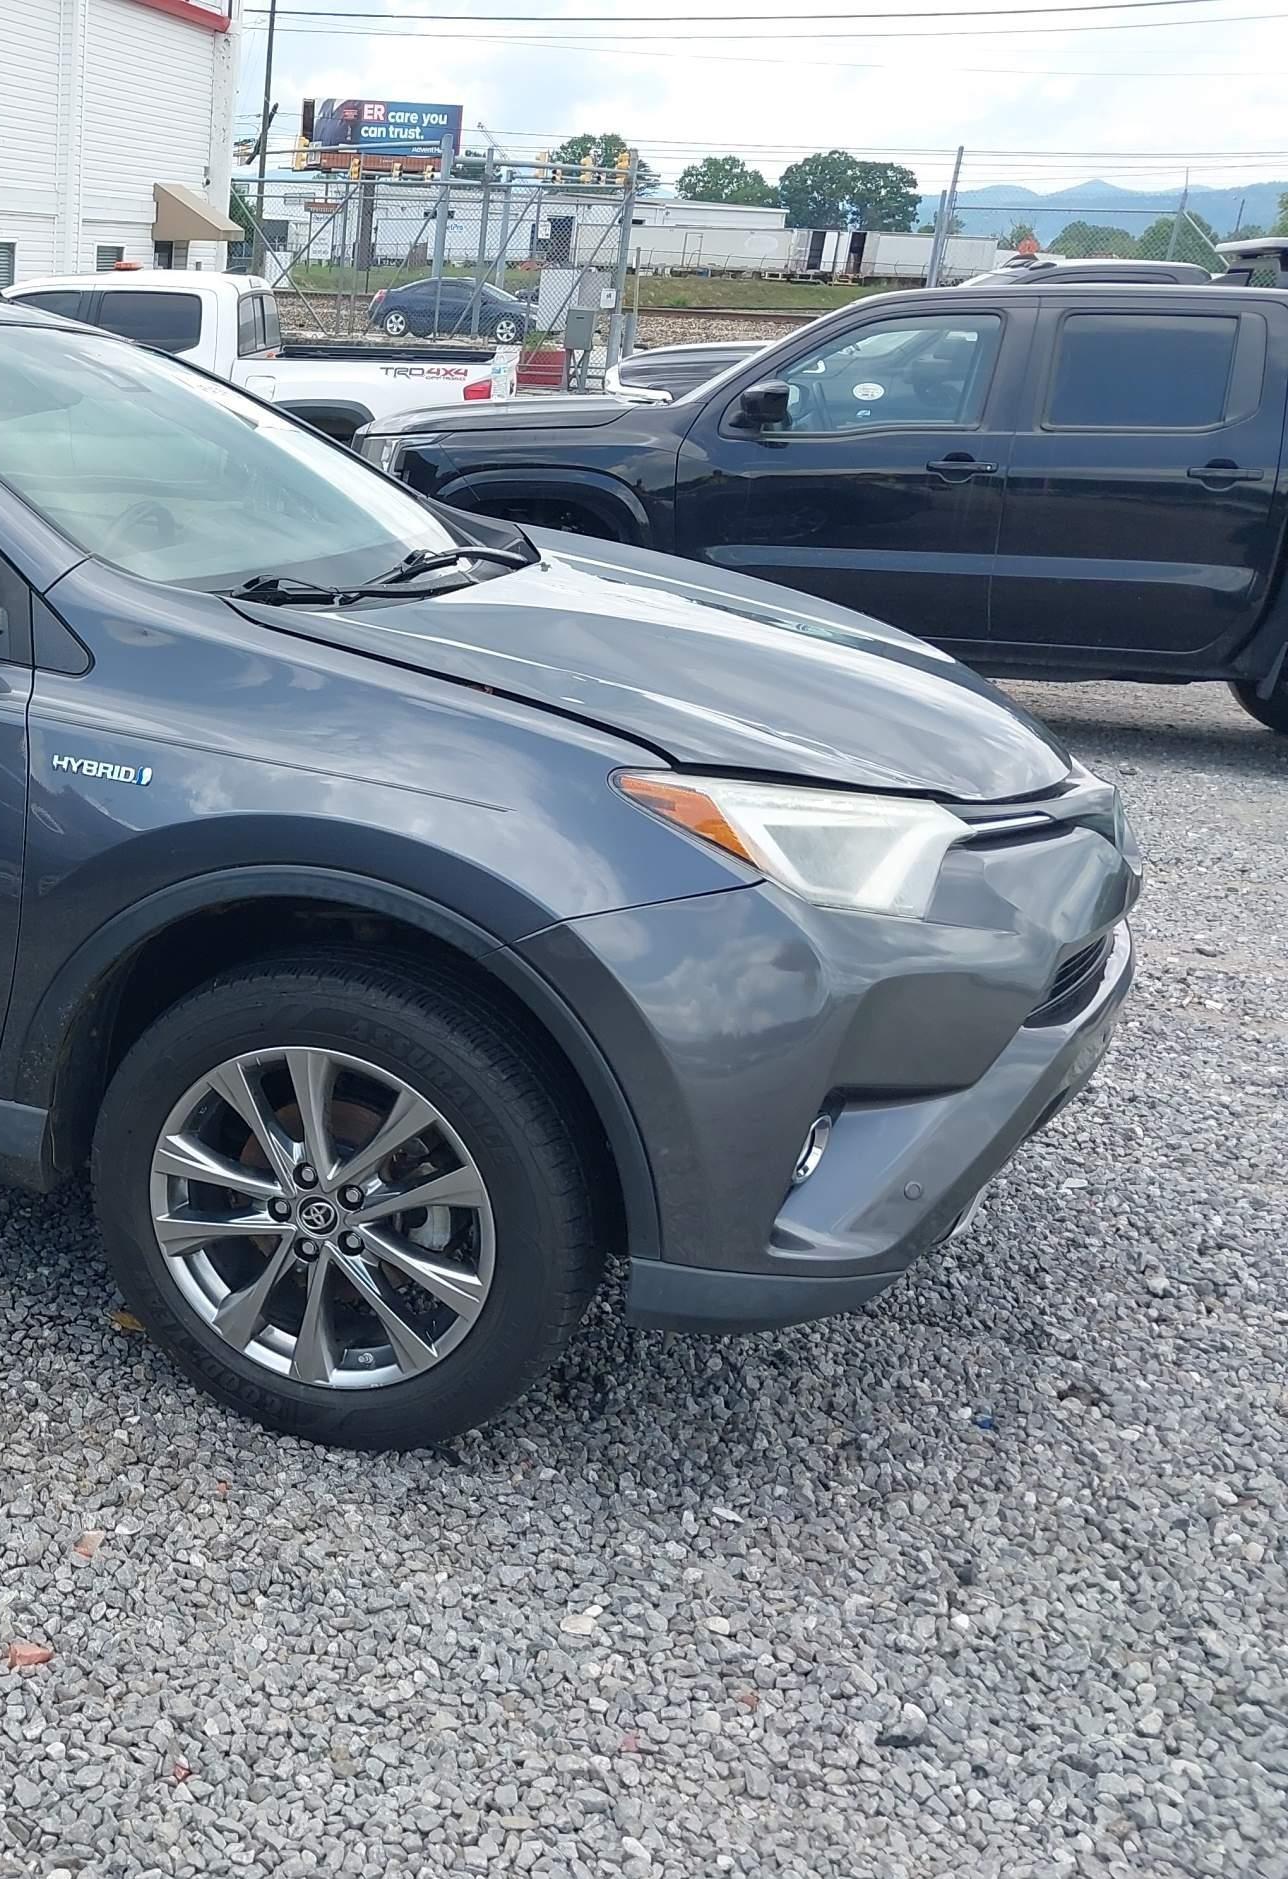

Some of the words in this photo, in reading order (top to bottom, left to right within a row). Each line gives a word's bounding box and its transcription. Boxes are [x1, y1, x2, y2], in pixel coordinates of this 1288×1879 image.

[363, 103, 385, 121] ER
[388, 111, 418, 123] care
[422, 113, 448, 127] you
[361, 125, 387, 138] can
[389, 126, 425, 139] trust.
[379, 366, 425, 379] TRD
[52, 754, 136, 784] HYBRID
